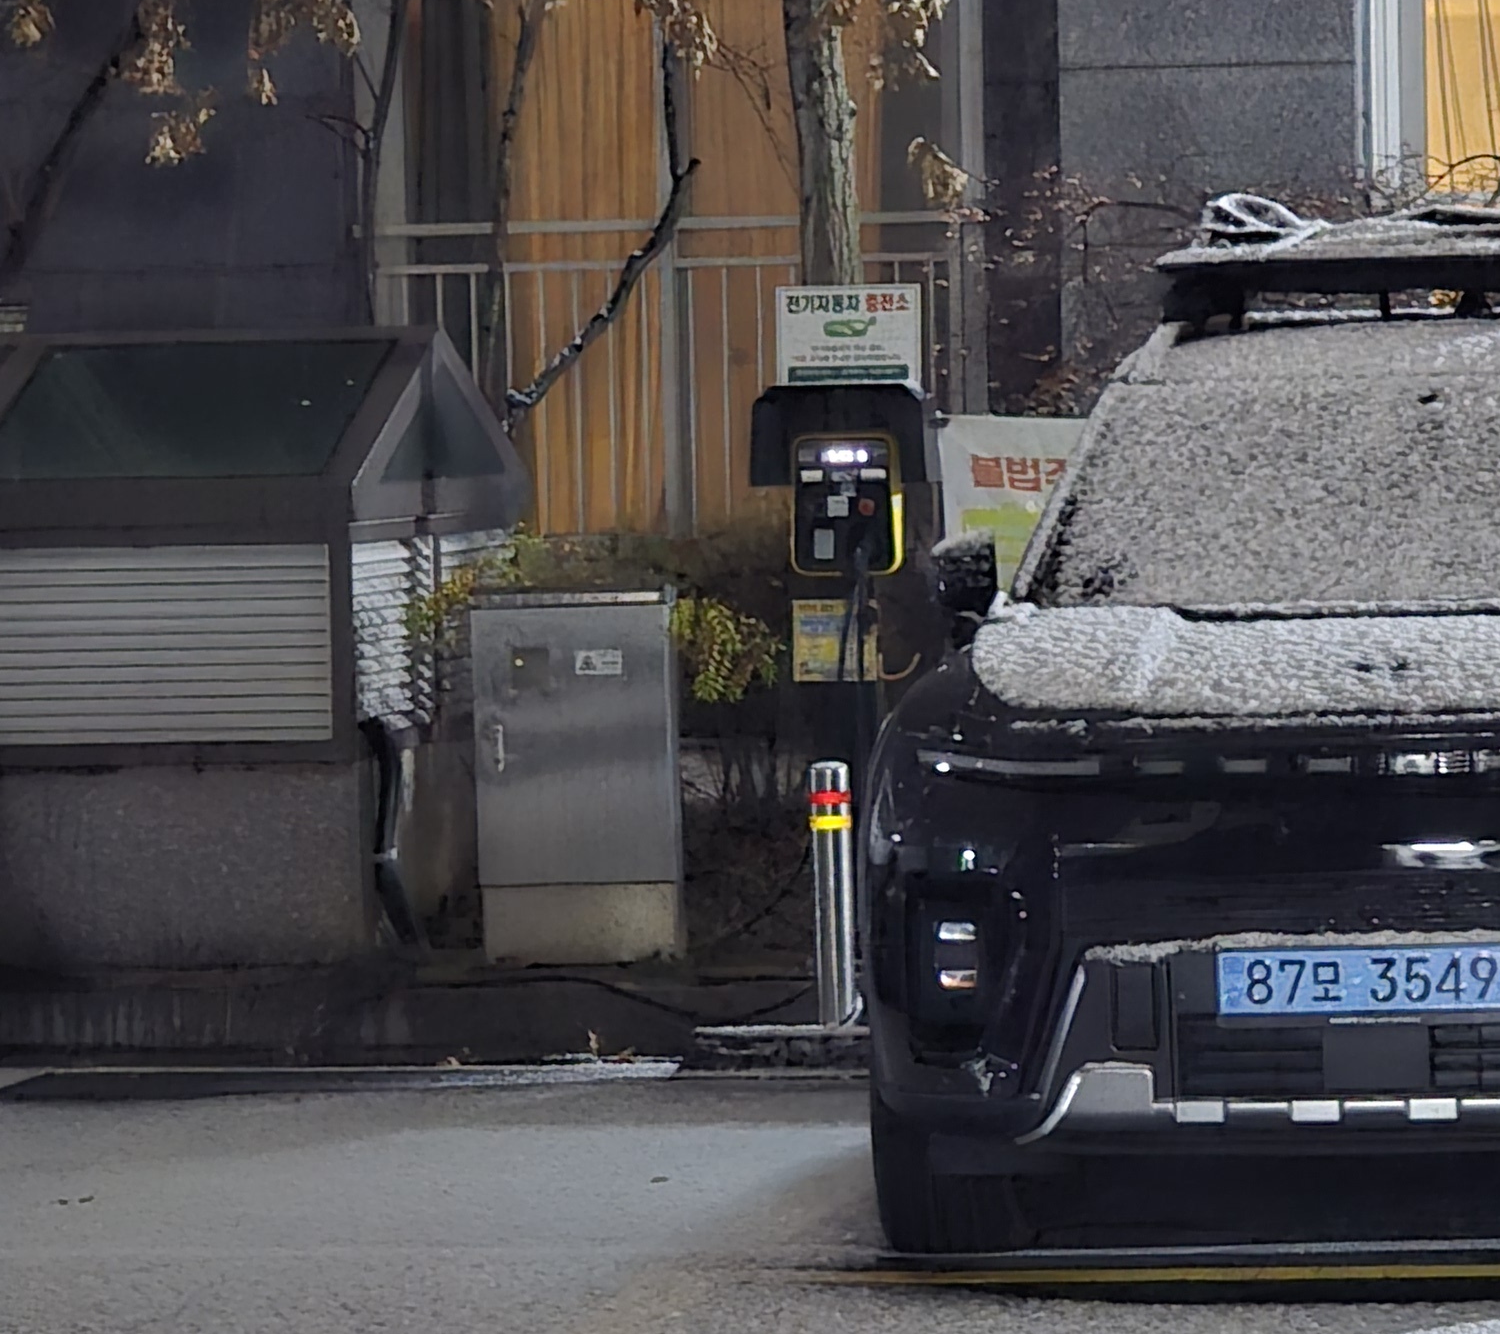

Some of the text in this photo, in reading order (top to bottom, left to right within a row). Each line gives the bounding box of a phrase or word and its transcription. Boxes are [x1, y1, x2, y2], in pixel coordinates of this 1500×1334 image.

[786, 292, 910, 314] 전기자동차 충전소
[1246, 953, 1499, 1005] 87모 3549
